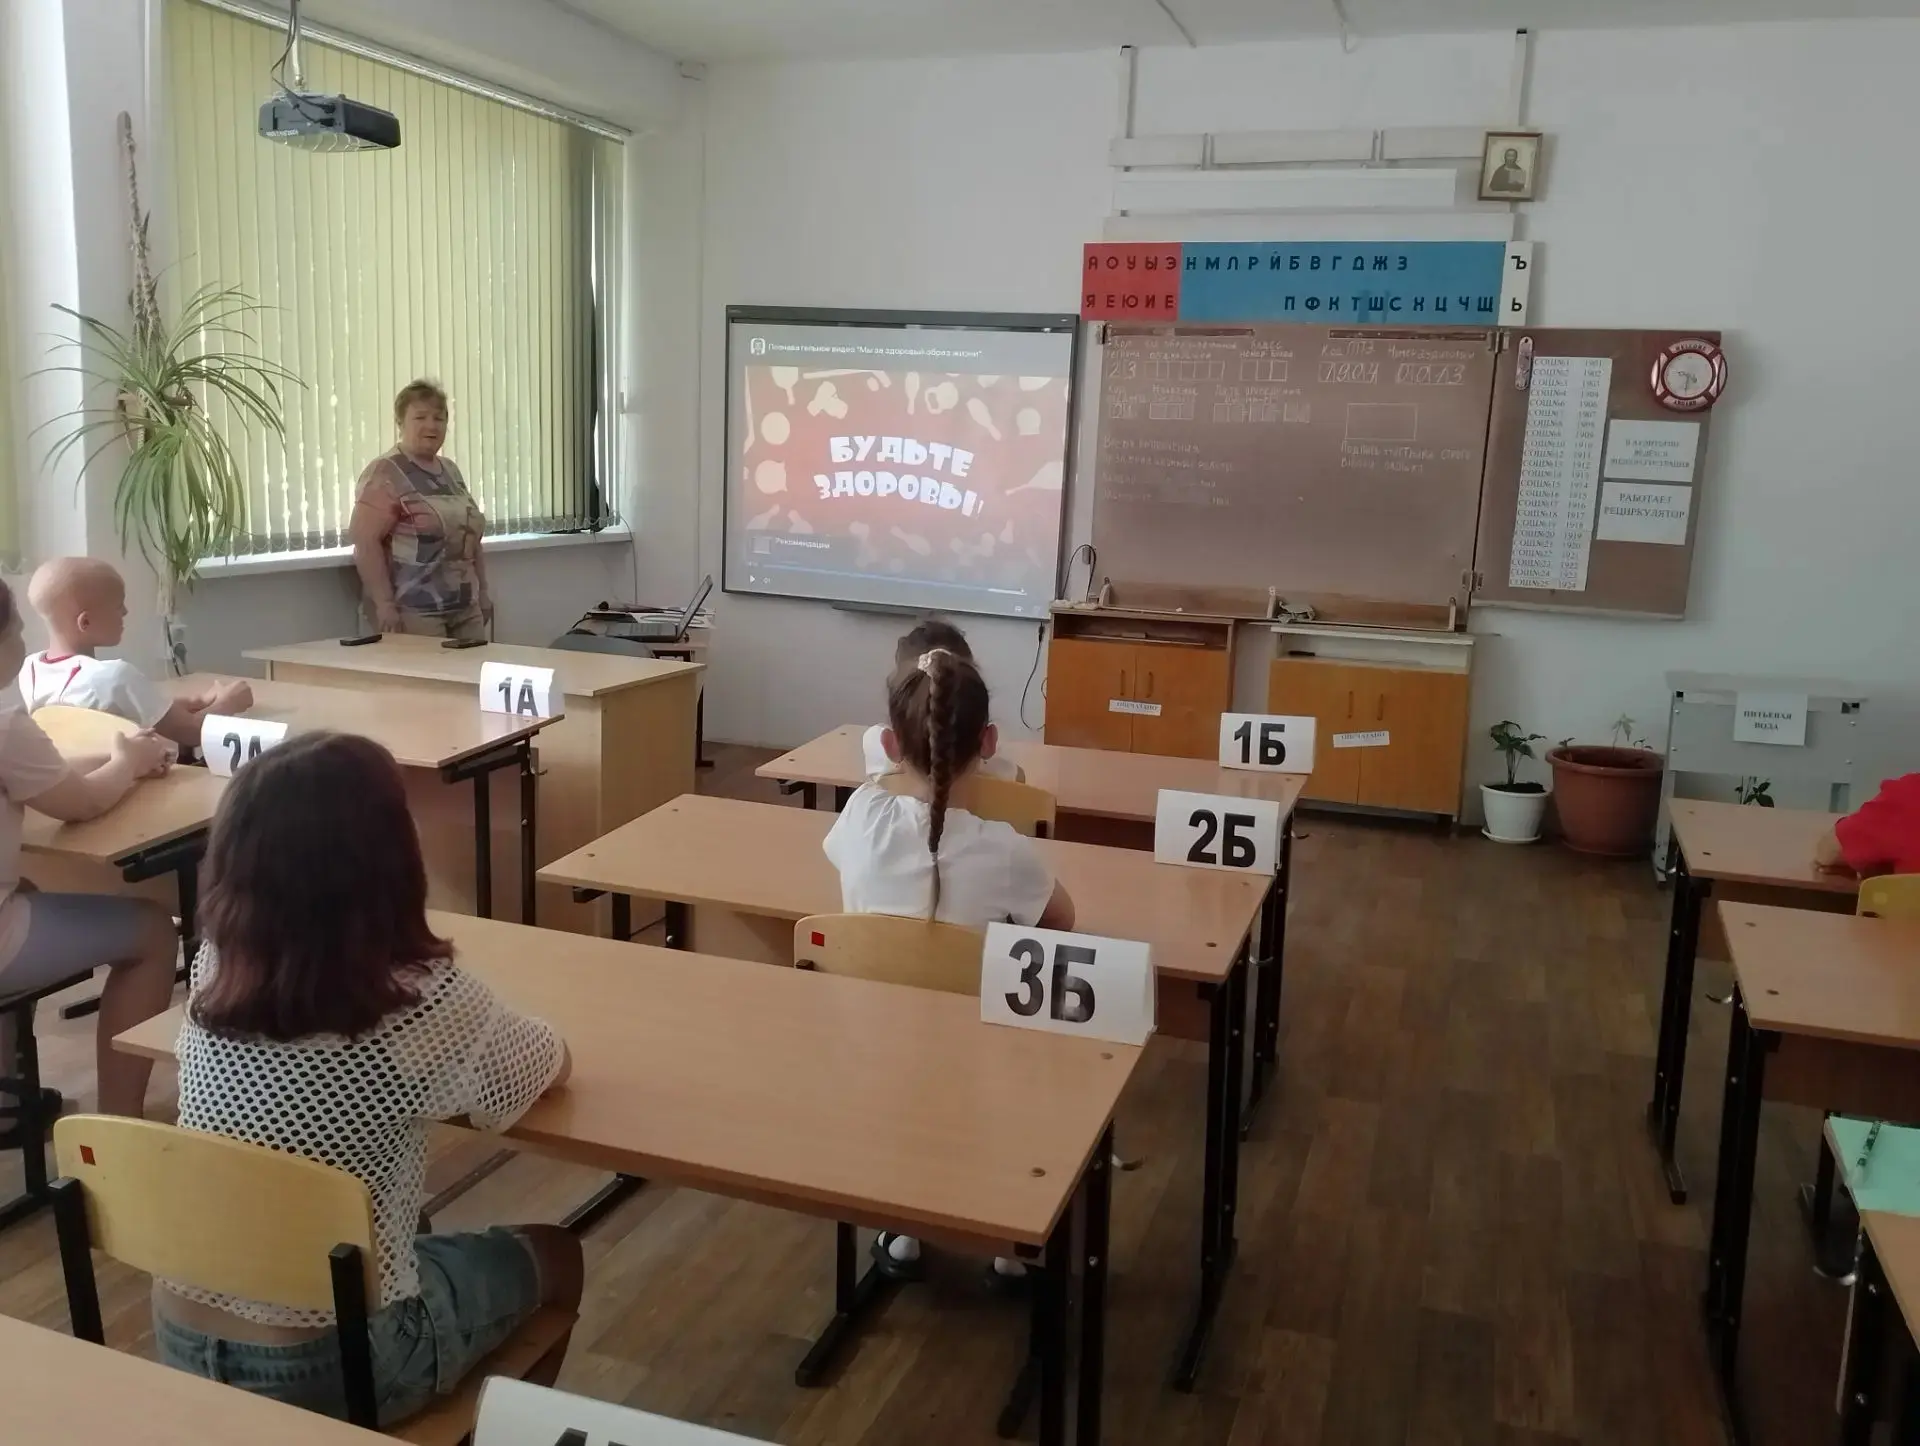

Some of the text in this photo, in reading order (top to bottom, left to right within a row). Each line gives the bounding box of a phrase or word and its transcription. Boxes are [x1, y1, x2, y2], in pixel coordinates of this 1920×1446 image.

[1511, 255, 1527, 270] Ъ
[830, 435, 975, 478] БУДЬТЕ
[814, 470, 984, 519] ЗДОРОВЫ!
[1604, 505, 1685, 519] РЕЦИРКУЛЯТОР
[1620, 492, 1672, 504] РАБОТАЕТ
[498, 676, 539, 717] 1А
[1233, 721, 1286, 765] 1Б
[1187, 809, 1256, 868] 2Б
[1004, 938, 1096, 1024] 3Б
